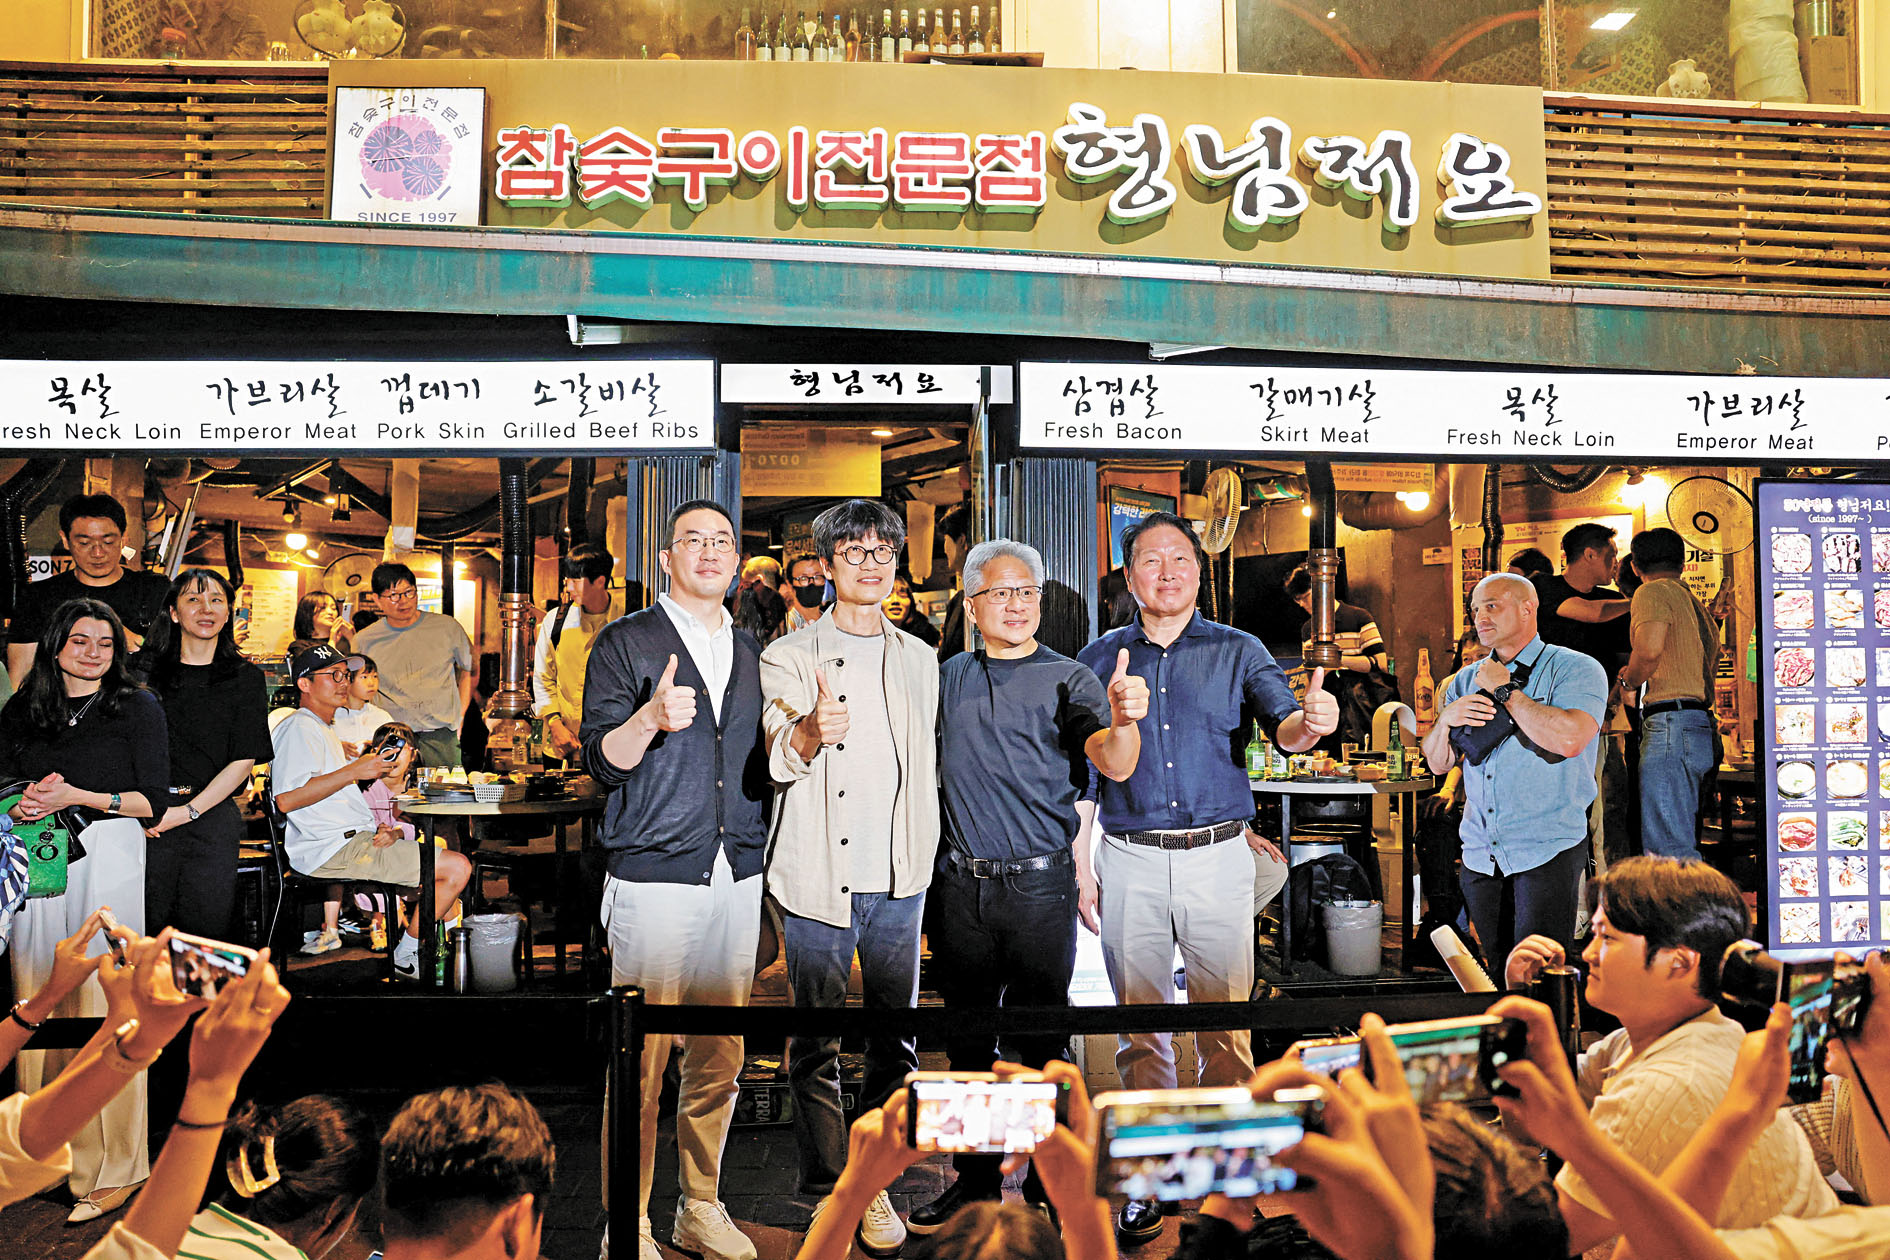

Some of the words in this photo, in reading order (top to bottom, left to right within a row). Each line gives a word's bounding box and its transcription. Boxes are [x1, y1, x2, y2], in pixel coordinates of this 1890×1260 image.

[495, 123, 1047, 209] 참숯구이전문점
[357, 212, 411, 222] SINCE
[419, 212, 457, 222] 1997
[47, 372, 120, 420] 목살
[206, 372, 347, 419] 가브리살
[380, 372, 480, 415] 껍데기
[534, 372, 666, 418] 소갈비살
[1062, 374, 1164, 420] 삼겹살
[1249, 377, 1381, 424] 갈매기살
[1502, 383, 1563, 427] 목살
[1686, 388, 1808, 432] 가브리살
[2, 422, 51, 440] resh
[65, 422, 121, 440] Neck
[135, 423, 181, 440] Loin
[200, 423, 292, 443] Emperor
[305, 422, 356, 439] Meat
[377, 423, 425, 440] Pork
[439, 422, 485, 440] Skin
[503, 422, 575, 439] Grilled
[590, 422, 638, 439] Beef
[652, 422, 699, 439] Ribs
[1045, 421, 1103, 439] Fresh
[1117, 422, 1182, 440] Bacon
[1261, 425, 1308, 442] Skirt
[1321, 426, 1369, 444] Meat
[1447, 428, 1501, 445] Fresh
[1513, 430, 1562, 447] Neck
[1574, 431, 1614, 447] Loin
[1677, 432, 1758, 452] Emperor
[1768, 434, 1815, 451] Meat
[1877, 435, 1890, 451] P
